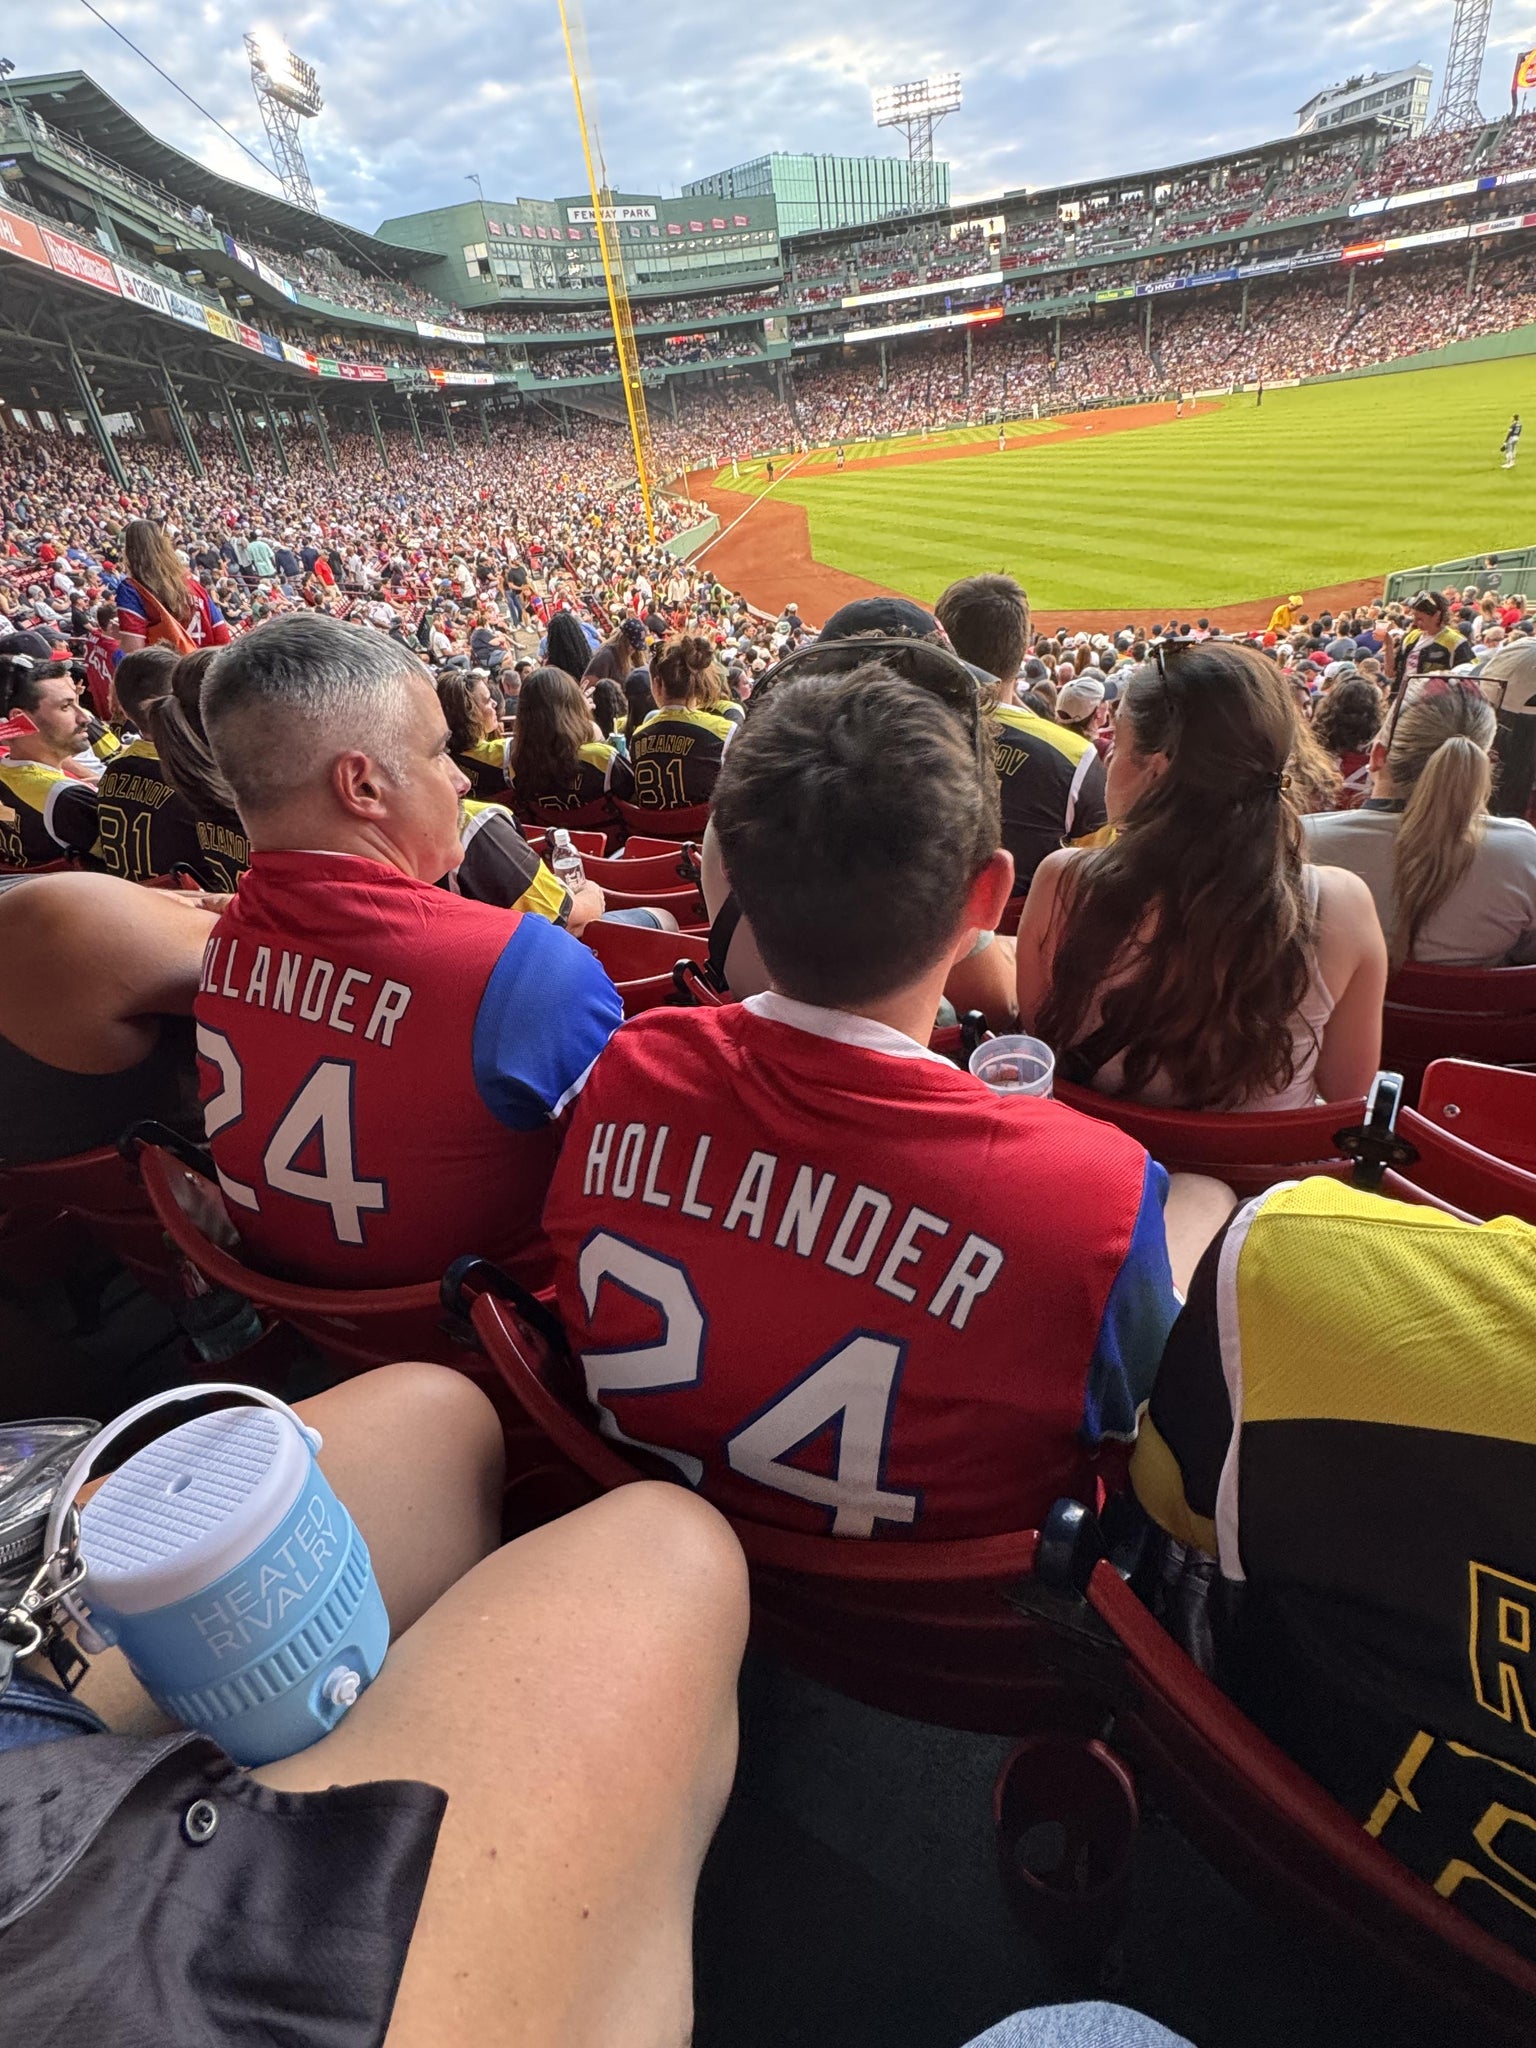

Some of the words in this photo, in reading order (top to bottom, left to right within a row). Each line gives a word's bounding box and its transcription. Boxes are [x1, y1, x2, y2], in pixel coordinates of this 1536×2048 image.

[622, 208, 651, 218] PARK
[1154, 281, 1176, 292] HYCU
[634, 758, 693, 811] 81
[582, 1122, 1005, 1331] HOLLANDER
[577, 1226, 924, 1540] 24
[189, 1493, 328, 1637] HEATED
[205, 1513, 339, 1660] RIVALRY
